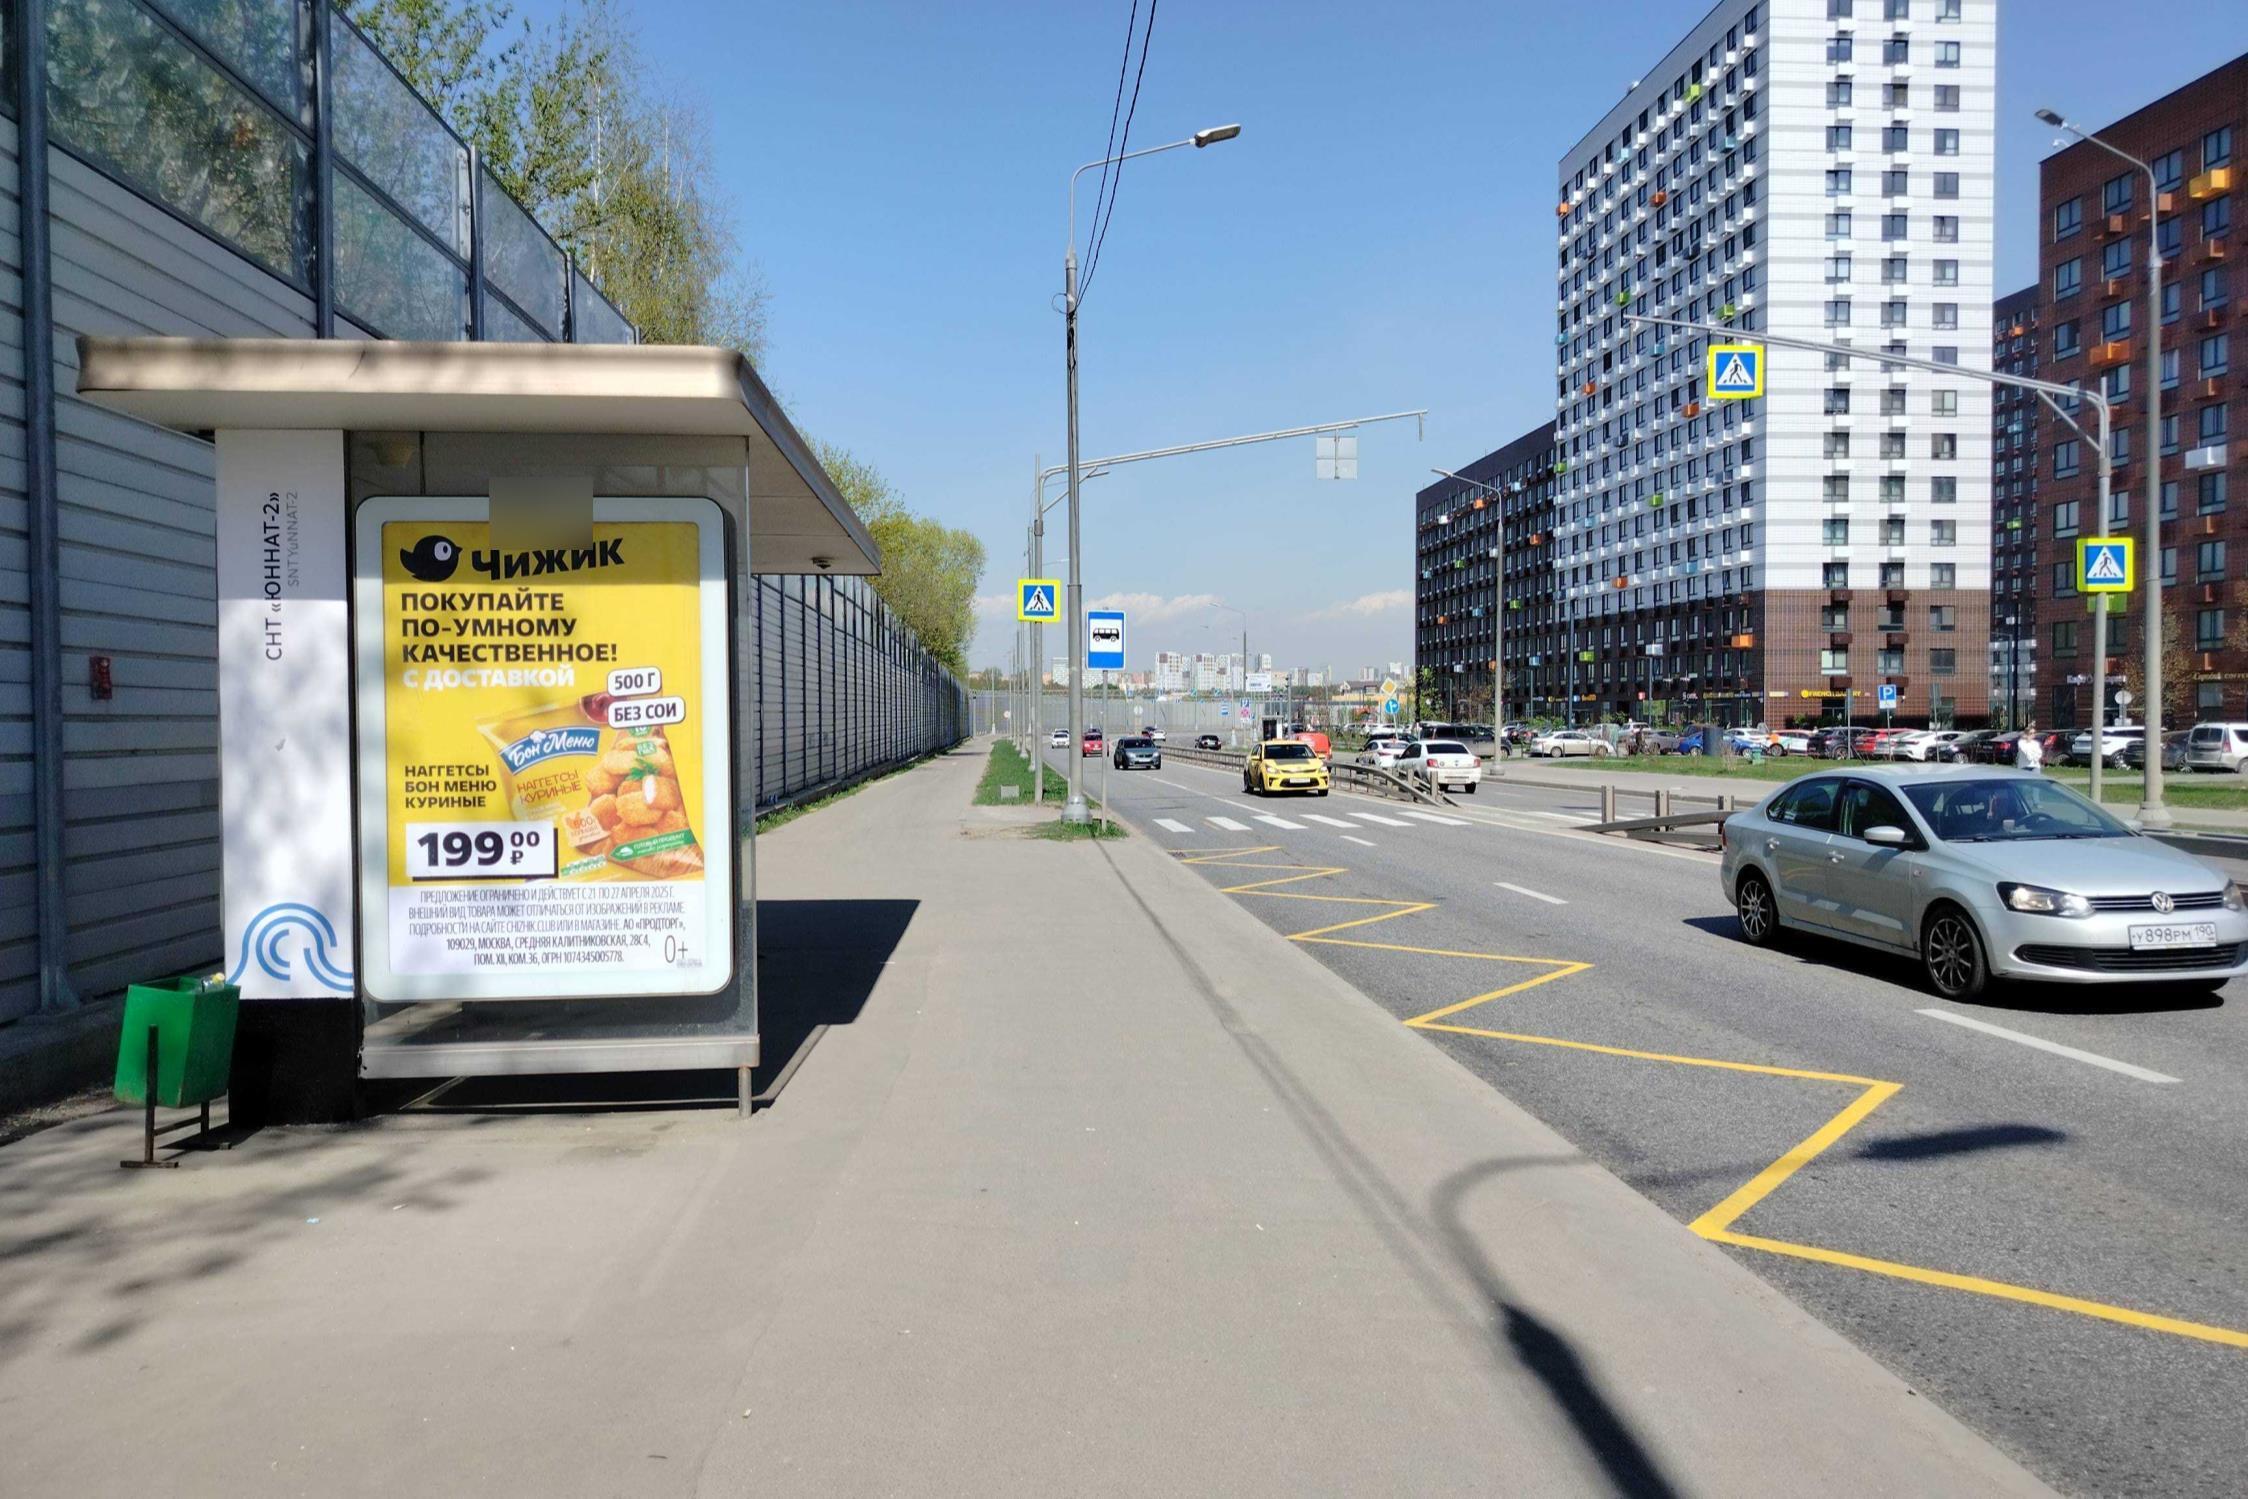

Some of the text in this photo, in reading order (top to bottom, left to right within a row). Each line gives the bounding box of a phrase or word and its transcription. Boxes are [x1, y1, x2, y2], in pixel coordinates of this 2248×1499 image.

[262, 491, 283, 661] СНТ «ЮННАТ-2»
[287, 559, 300, 587] SNT
[401, 587, 564, 612] ПОКУПАЙТЕ
[401, 617, 577, 638] ПО-УМНОМУ
[402, 643, 618, 663] КАЧЕСТВЕННОЕ!
[402, 663, 576, 692] С ДОСТАВКОЙ
[614, 672, 655, 691] 500 Г
[614, 702, 677, 723] БЕЗ СОИ
[508, 731, 595, 767] Бон Меню
[404, 764, 489, 778] НАГГЕТСЫ
[517, 769, 579, 793] НАГГЕТСЫ
[404, 780, 497, 793] БОН МЕНЮ
[520, 781, 582, 804] КУРИНЫЕ
[405, 796, 487, 809] КУРИНЫЕ
[417, 831, 504, 867] 199
[510, 831, 540, 848] 00
[420, 889, 479, 904] ПРЕДЛОЖЕНИЕ
[480, 888, 530, 902] ОГРАНИЧЕНО
[531, 888, 537, 900] И
[538, 885, 581, 902] ДЕЙСТВУЕТ
[599, 887, 610, 899] ПО
[611, 887, 620, 899] 27
[620, 886, 650, 899] АПРЕЛЯ
[651, 886, 668, 898] 2025
[409, 904, 448, 919] ВНЕШНИЙ
[449, 906, 466, 920] ВИД
[467, 905, 496, 918] ТОВАРА
[497, 904, 525, 918] МОЖЕТ
[526, 902, 574, 917] ОТЛИЧАТЬСЯ
[575, 903, 585, 916] ОТ
[586, 900, 643, 915] ИЗОБРАЖЕНИЙ
[643, 902, 649, 914] В
[409, 922, 468, 937] ПОДРОБНОСТИ
[469, 921, 480, 933] НА
[481, 919, 506, 933] САЙТЕ
[557, 920, 574, 932] ИЛИ
[574, 919, 580, 932] В
[623, 918, 634, 930] АО
[446, 938, 477, 952] 109029,
[478, 937, 513, 951] МОСКВА,
[515, 936, 551, 950] СРЕДНЯЯ
[552, 934, 628, 948] КАЛИТНИКОВСКАЯ,
[664, 935, 689, 963] 0+
[474, 953, 494, 966] ПОМ.
[541, 952, 562, 965] ОГРН
